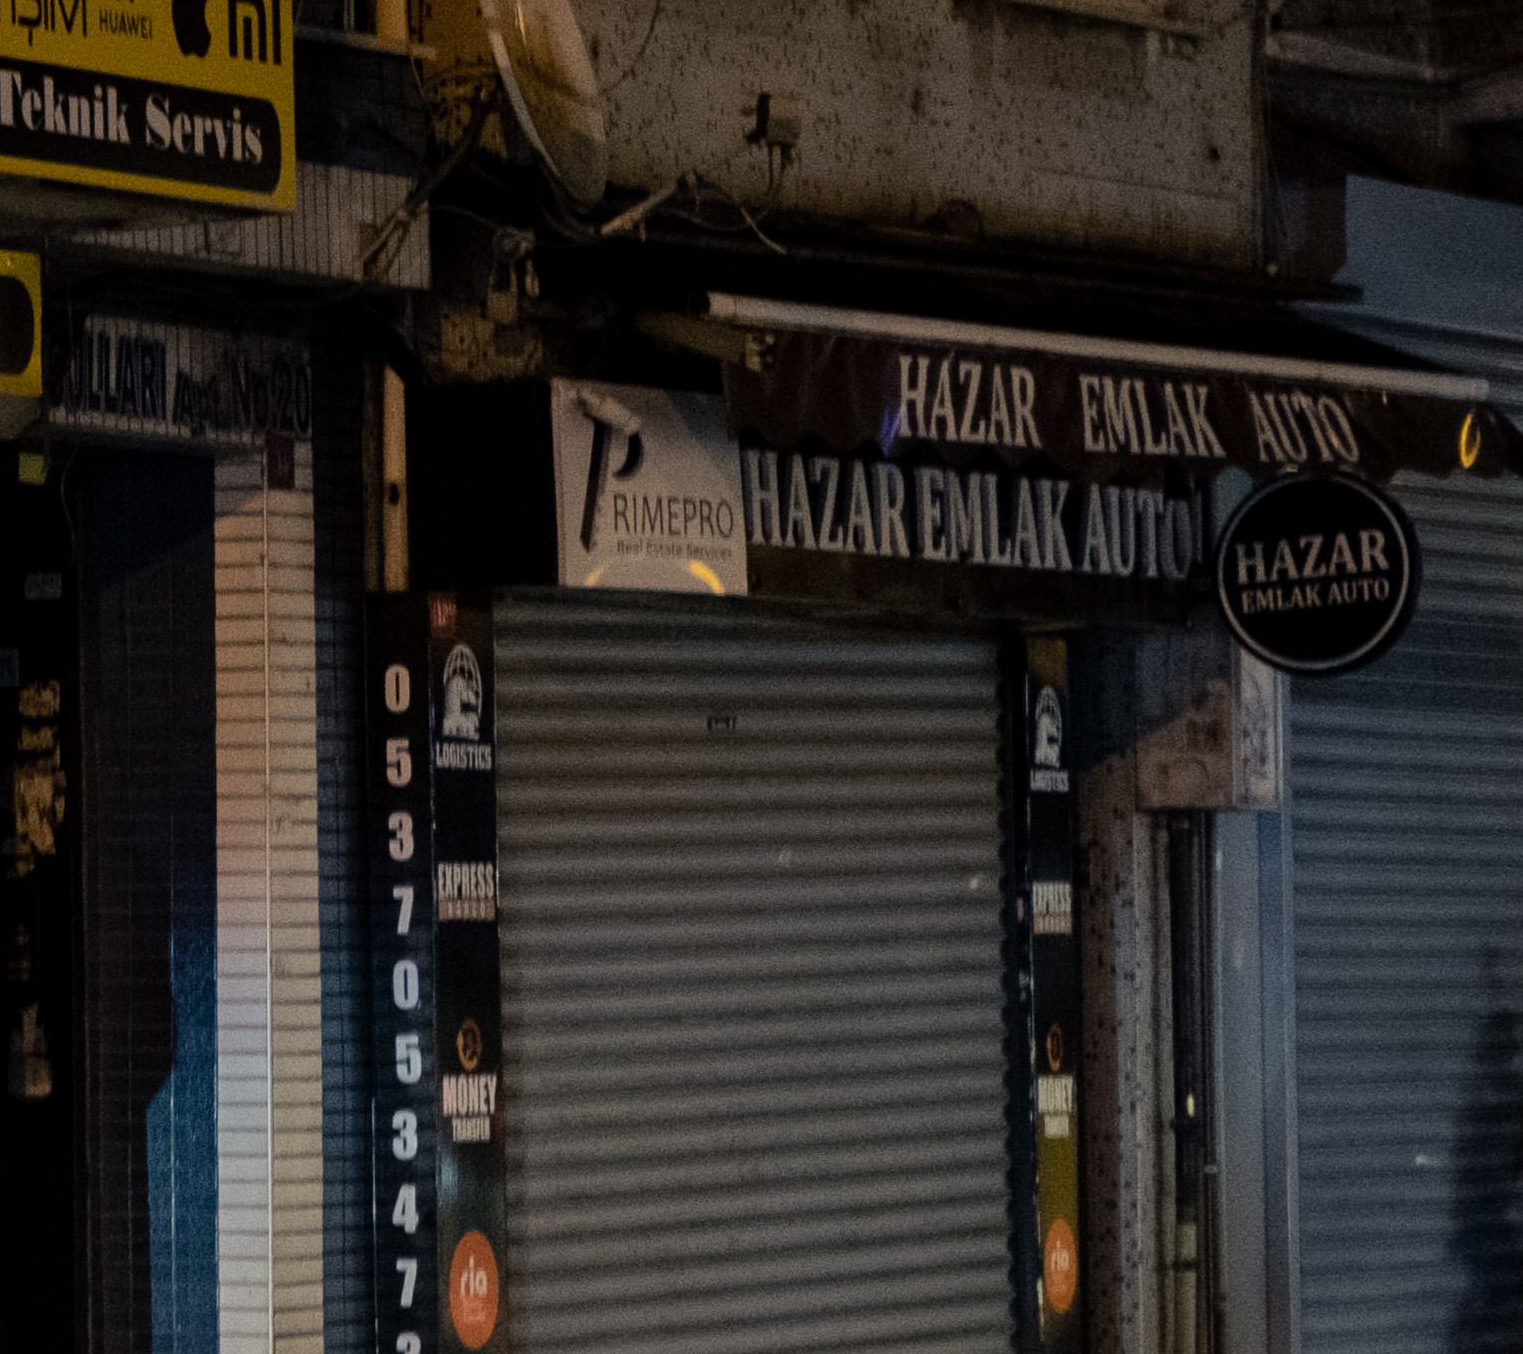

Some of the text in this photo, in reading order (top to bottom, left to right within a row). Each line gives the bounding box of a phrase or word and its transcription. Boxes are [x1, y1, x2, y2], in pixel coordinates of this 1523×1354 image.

[99, 12, 154, 40] HUAWEI
[144, 90, 265, 166] Servis
[1078, 373, 1227, 460] EMLAK
[1249, 389, 1360, 464] AUTO
[743, 446, 1194, 582] HAZAR EMLAK AUTO
[1234, 525, 1392, 587] HAZAR
[1240, 575, 1391, 616] EMLAK AUTO
[437, 860, 495, 901] EXPRESS
[441, 1073, 498, 1118] MONEY
